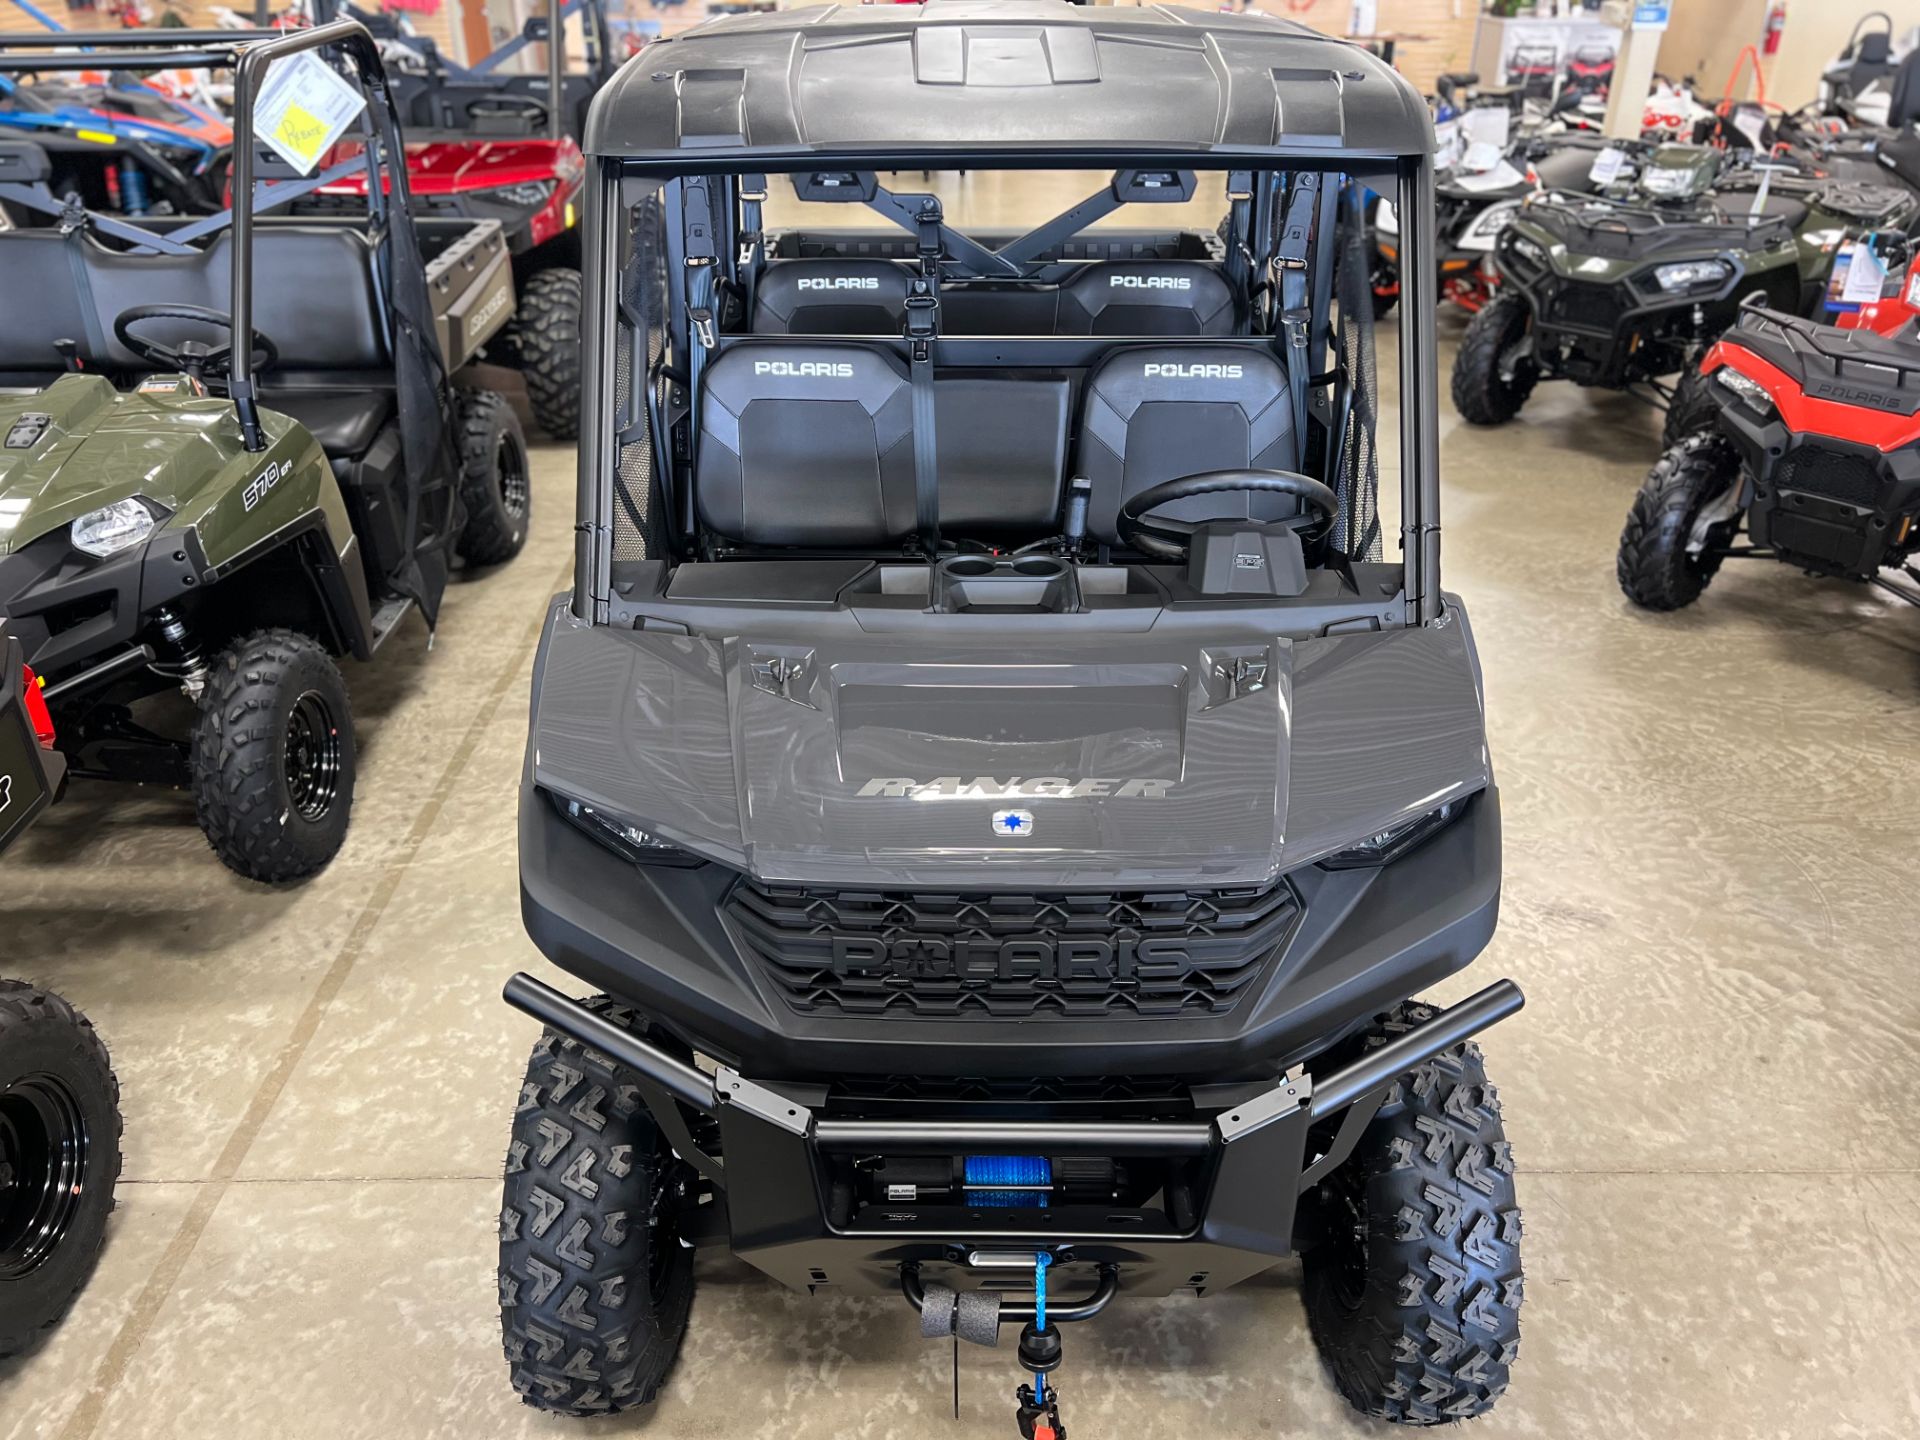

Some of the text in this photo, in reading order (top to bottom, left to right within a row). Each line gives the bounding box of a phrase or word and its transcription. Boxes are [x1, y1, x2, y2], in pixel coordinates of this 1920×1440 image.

[797, 277, 879, 291] POLARIS
[1110, 275, 1191, 290] POLARIS
[754, 361, 855, 378] POLARIS
[1144, 363, 1244, 380] POLARIS
[1818, 383, 1902, 409] POLARIS
[242, 460, 280, 512] 570
[854, 776, 1175, 799] RANGER
[831, 934, 1193, 979] POLARIS
